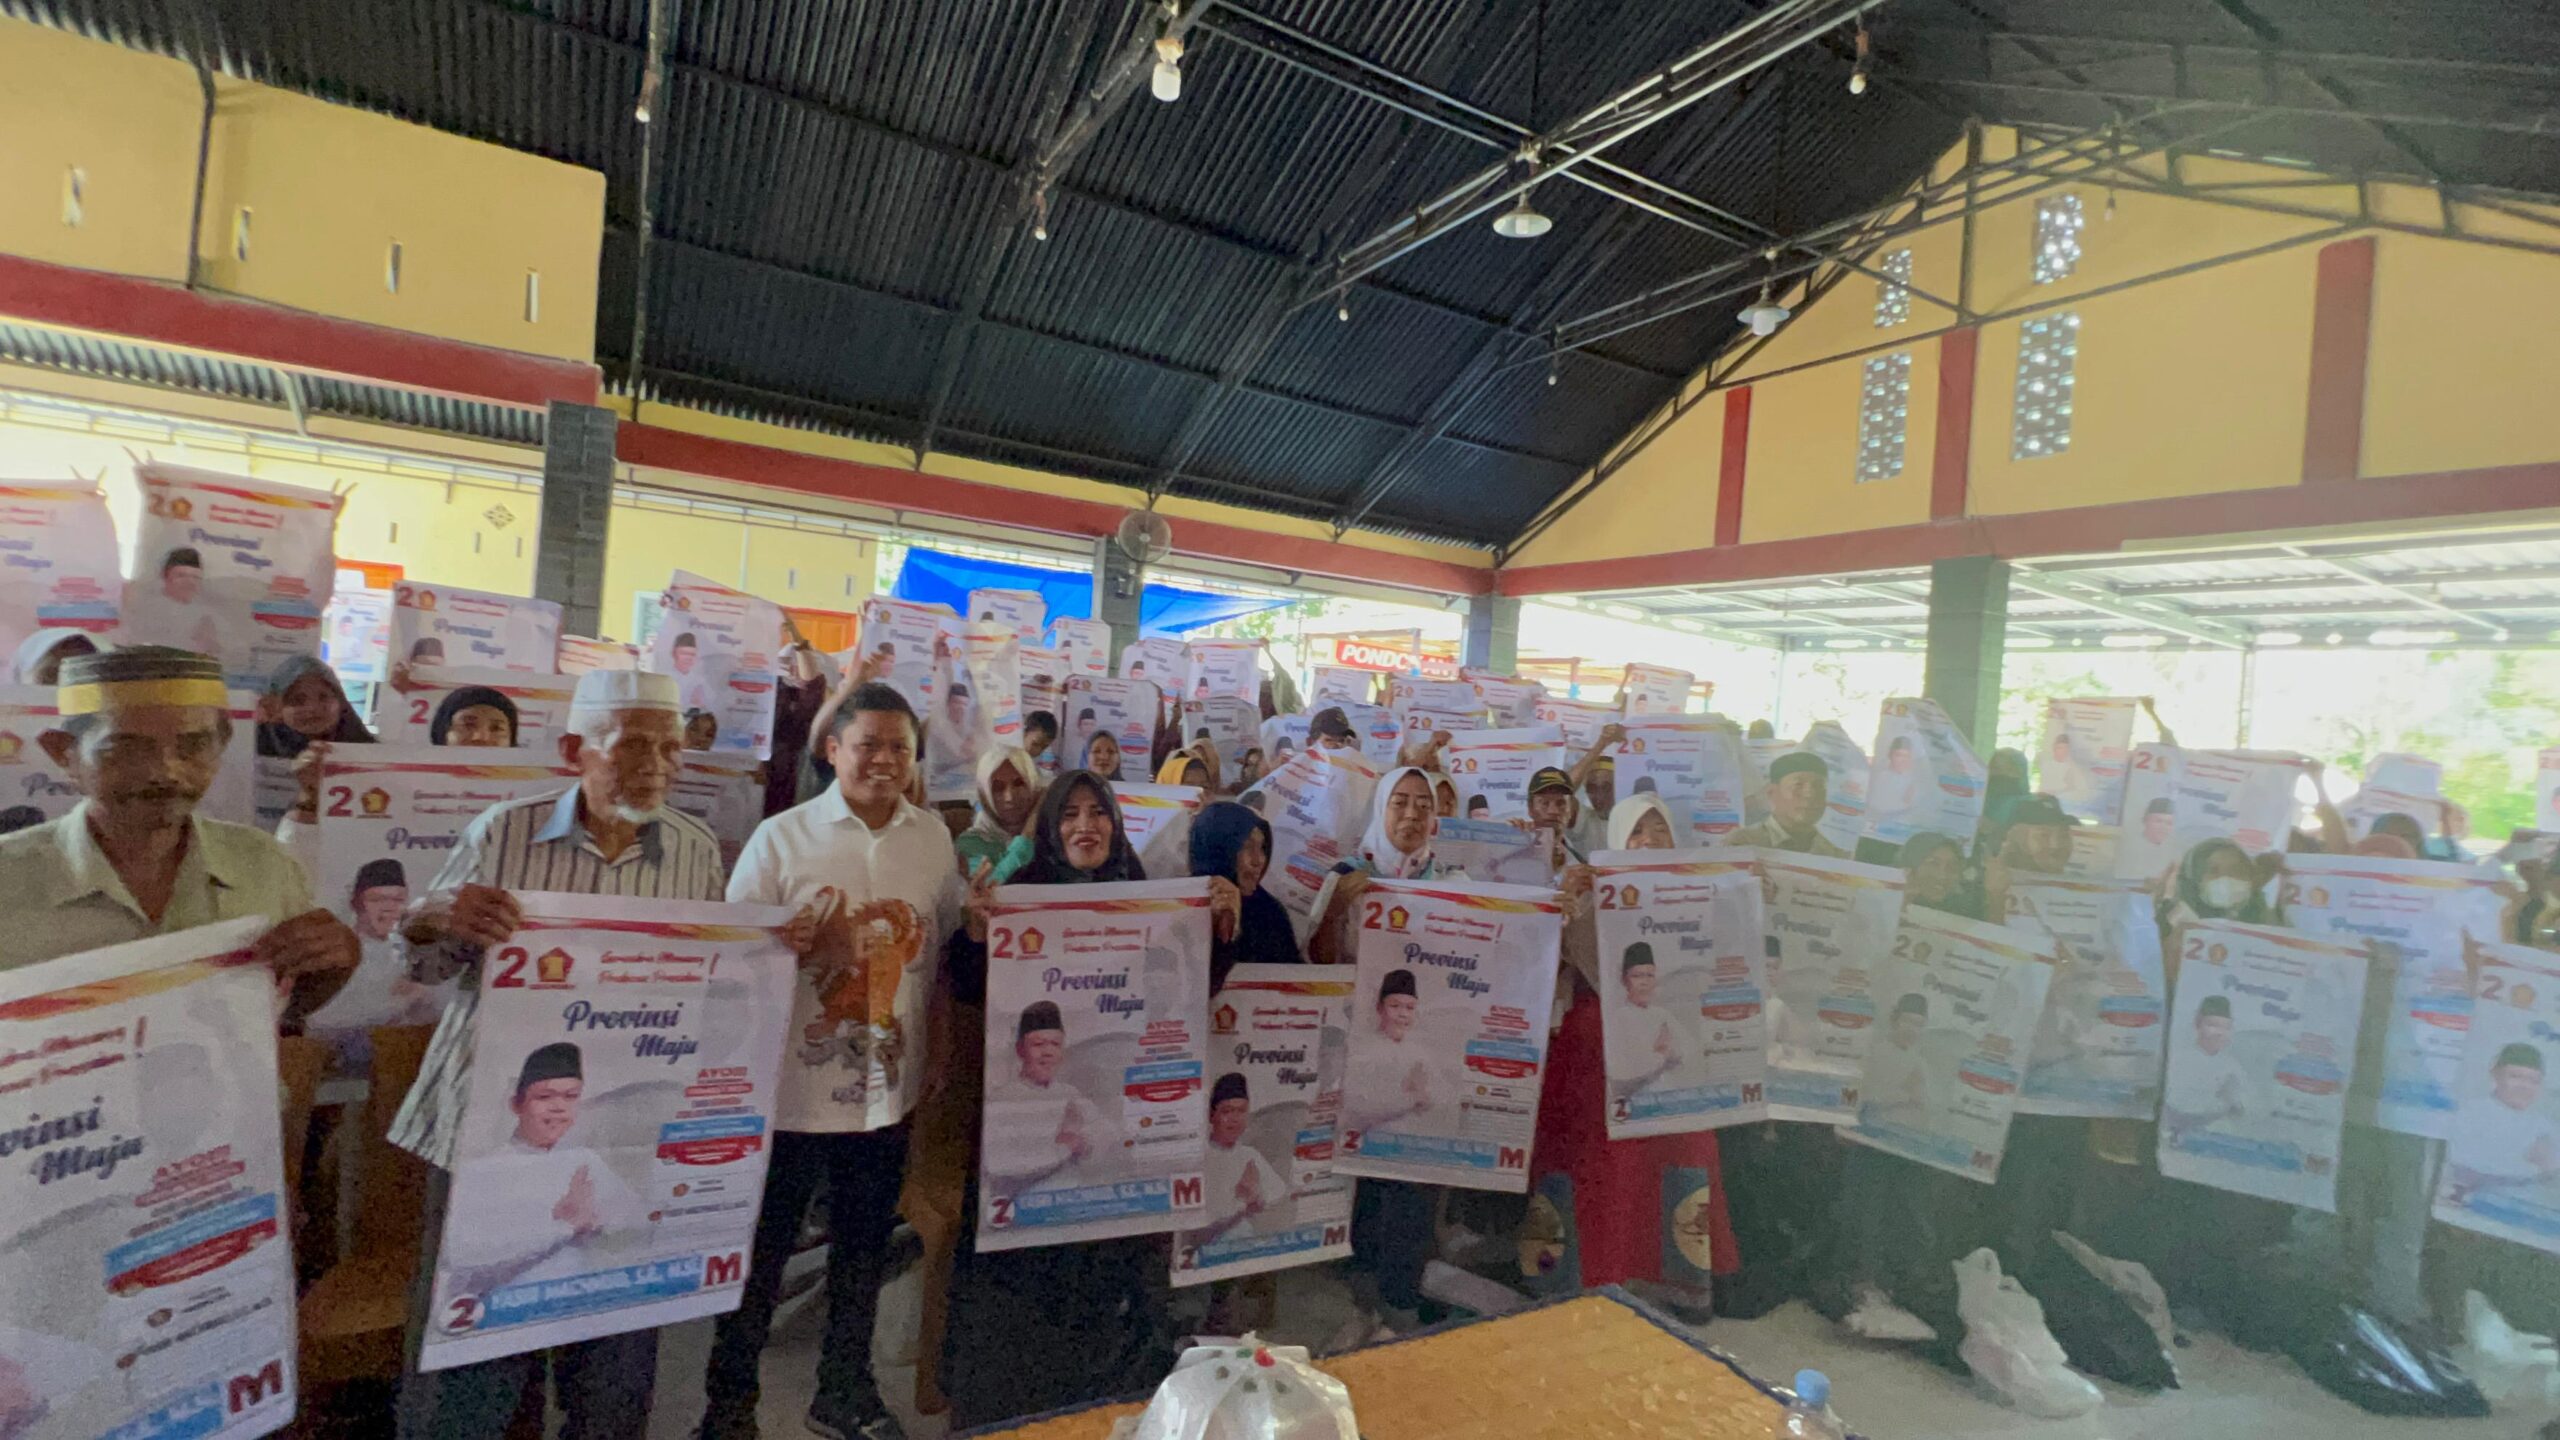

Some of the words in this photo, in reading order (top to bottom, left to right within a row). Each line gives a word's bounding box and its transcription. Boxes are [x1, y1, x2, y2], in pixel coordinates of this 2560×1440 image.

[398, 586, 414, 607] 2
[408, 699, 430, 724] 2
[1409, 716, 1418, 729] 2
[1451, 758, 1463, 774] 2
[2136, 752, 2153, 769] 2
[328, 786, 353, 817] 2
[1600, 884, 1616, 910] 2
[1364, 901, 1383, 929] 2
[993, 927, 1014, 959] 2
[2185, 937, 2205, 960] 2
[493, 946, 528, 988] 2
[1404, 942, 1480, 971] Provinsi
[1043, 967, 1129, 992] Provinsi
[1448, 972, 1490, 998] Maju
[2481, 975, 2503, 1000] 2
[563, 1000, 683, 1031] Provinsi
[1096, 994, 1144, 1019] Maju
[632, 1034, 698, 1064] Maju
[1234, 1043, 1307, 1065] Provinsi
[1344, 1130, 1361, 1149] 2
[31, 1134, 144, 1184] Maju
[1500, 1147, 1524, 1168] M
[1174, 1177, 1201, 1206] M
[993, 1198, 1014, 1224] 2
[1324, 1225, 1346, 1247] M
[704, 1252, 742, 1287] M
[449, 1297, 476, 1329] 2
[227, 1358, 283, 1414] M
